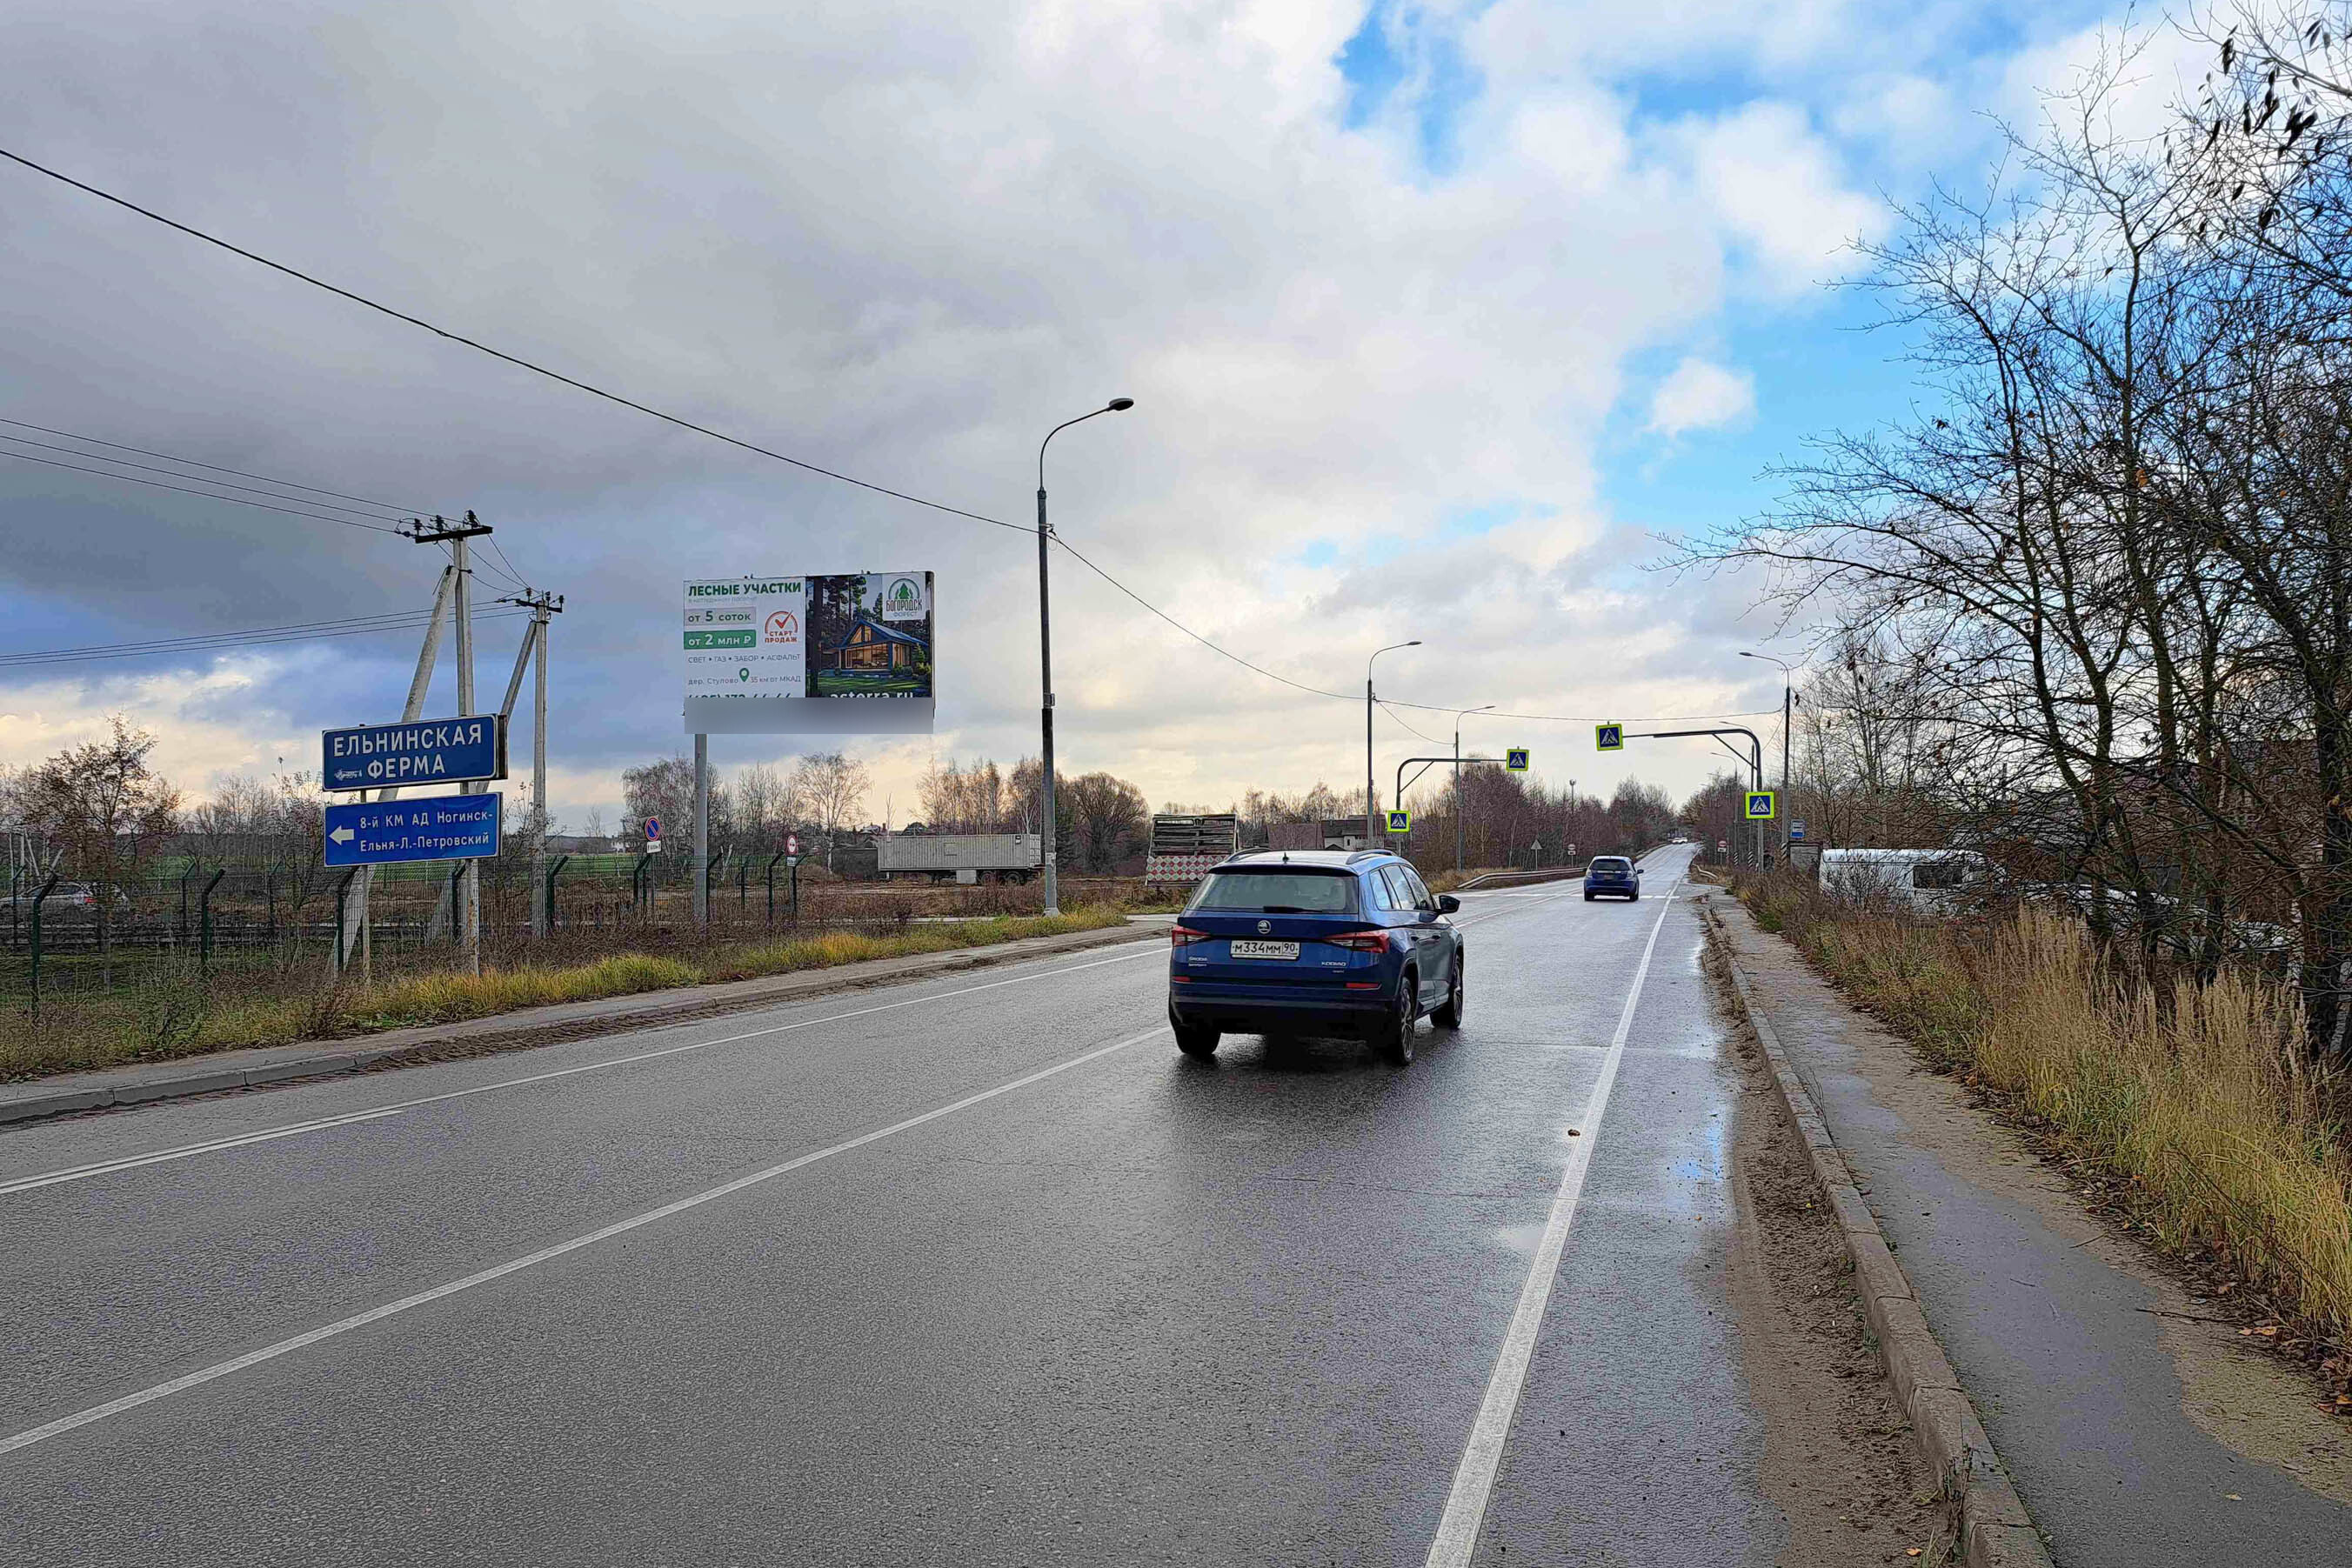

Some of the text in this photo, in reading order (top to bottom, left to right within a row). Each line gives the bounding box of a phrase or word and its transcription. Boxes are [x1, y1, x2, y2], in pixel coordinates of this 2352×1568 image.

[688, 582, 801, 597] ЛЕСНЫЕ УЧАСТКИ
[885, 598, 923, 612] БОГОРОДСК
[705, 611, 713, 622] 5
[718, 612, 752, 622] соток
[688, 637, 701, 646] от
[705, 633, 714, 645] 2
[733, 654, 759, 663] ЗАБОР
[765, 652, 801, 662] АСФАЛЬТ
[688, 677, 704, 686] дер.
[707, 677, 739, 686] Стулово
[778, 675, 802, 684] МКАД
[333, 723, 483, 757] ЕЛЬНИНСКАЯ
[366, 753, 446, 779] ФЕРМА
[359, 810, 494, 830] 8-й КМ АД Ногинск-
[359, 831, 490, 852] Ельня-Л.-Петровский
